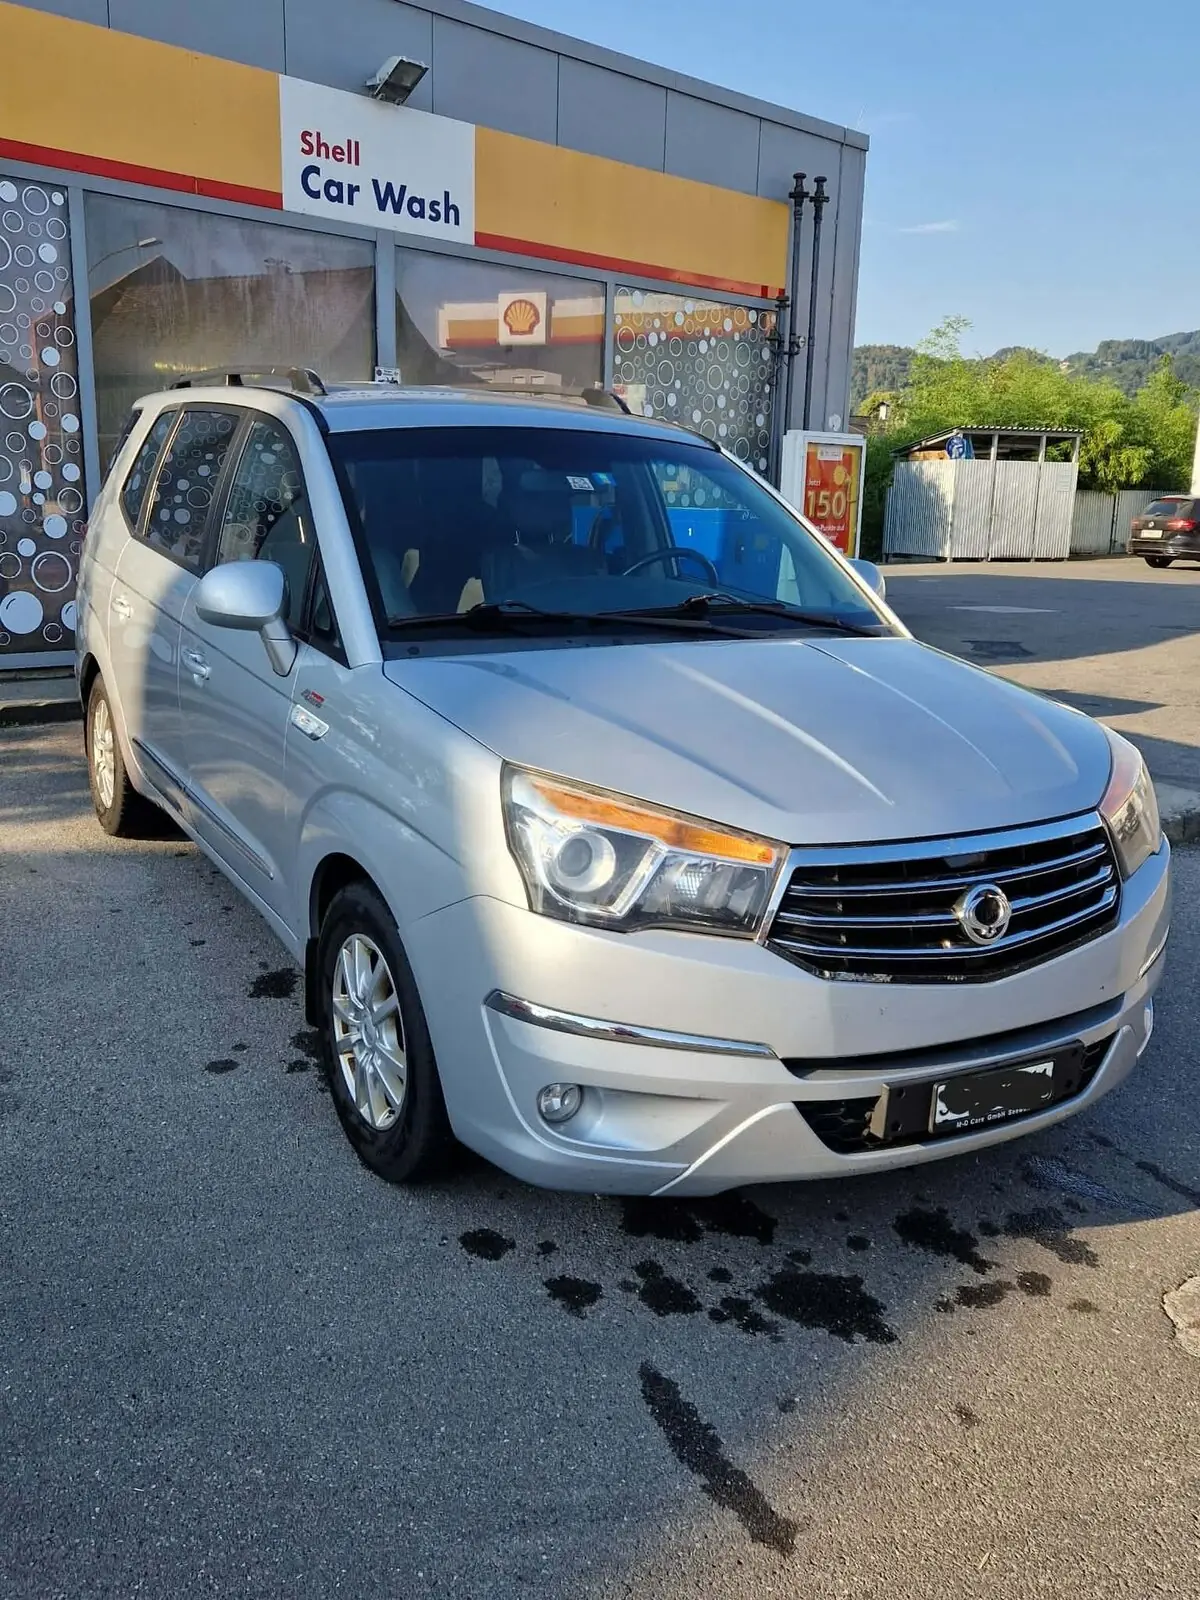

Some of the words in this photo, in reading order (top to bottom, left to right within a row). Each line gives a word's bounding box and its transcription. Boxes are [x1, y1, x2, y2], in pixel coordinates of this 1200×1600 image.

[300, 130, 360, 166] Shell
[301, 164, 361, 206] Car
[371, 178, 460, 226] Wash
[807, 490, 846, 519] 150
[987, 1111, 1006, 1121] GmbH
